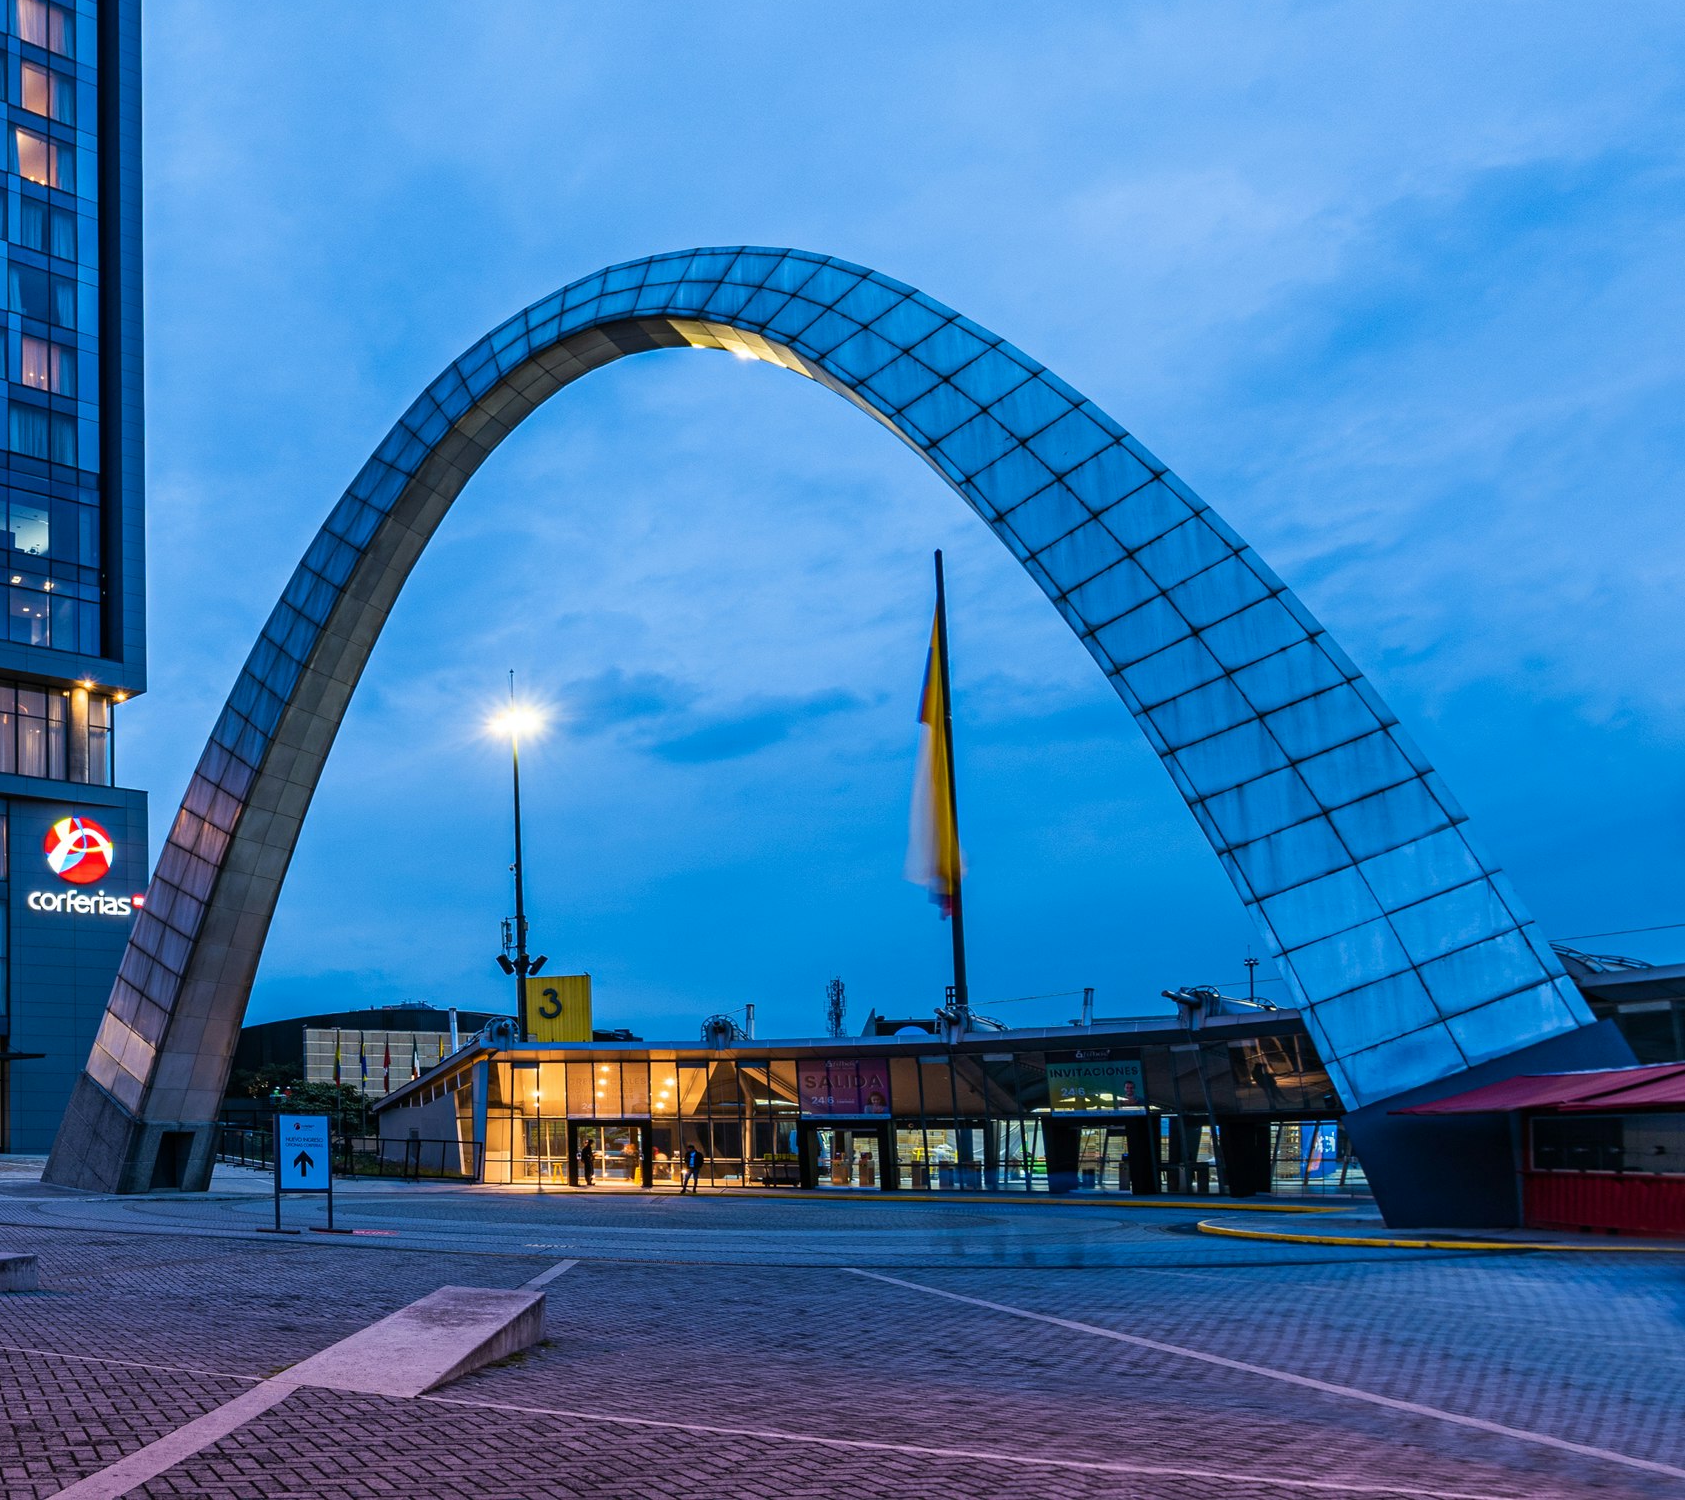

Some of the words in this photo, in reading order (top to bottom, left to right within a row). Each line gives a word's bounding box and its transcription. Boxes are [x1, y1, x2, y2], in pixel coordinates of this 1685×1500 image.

[28, 890, 131, 915] corferias
[539, 988, 562, 1019] 3
[805, 1075, 884, 1089] SALIDA
[1050, 1067, 1139, 1078] INVITACIONES
